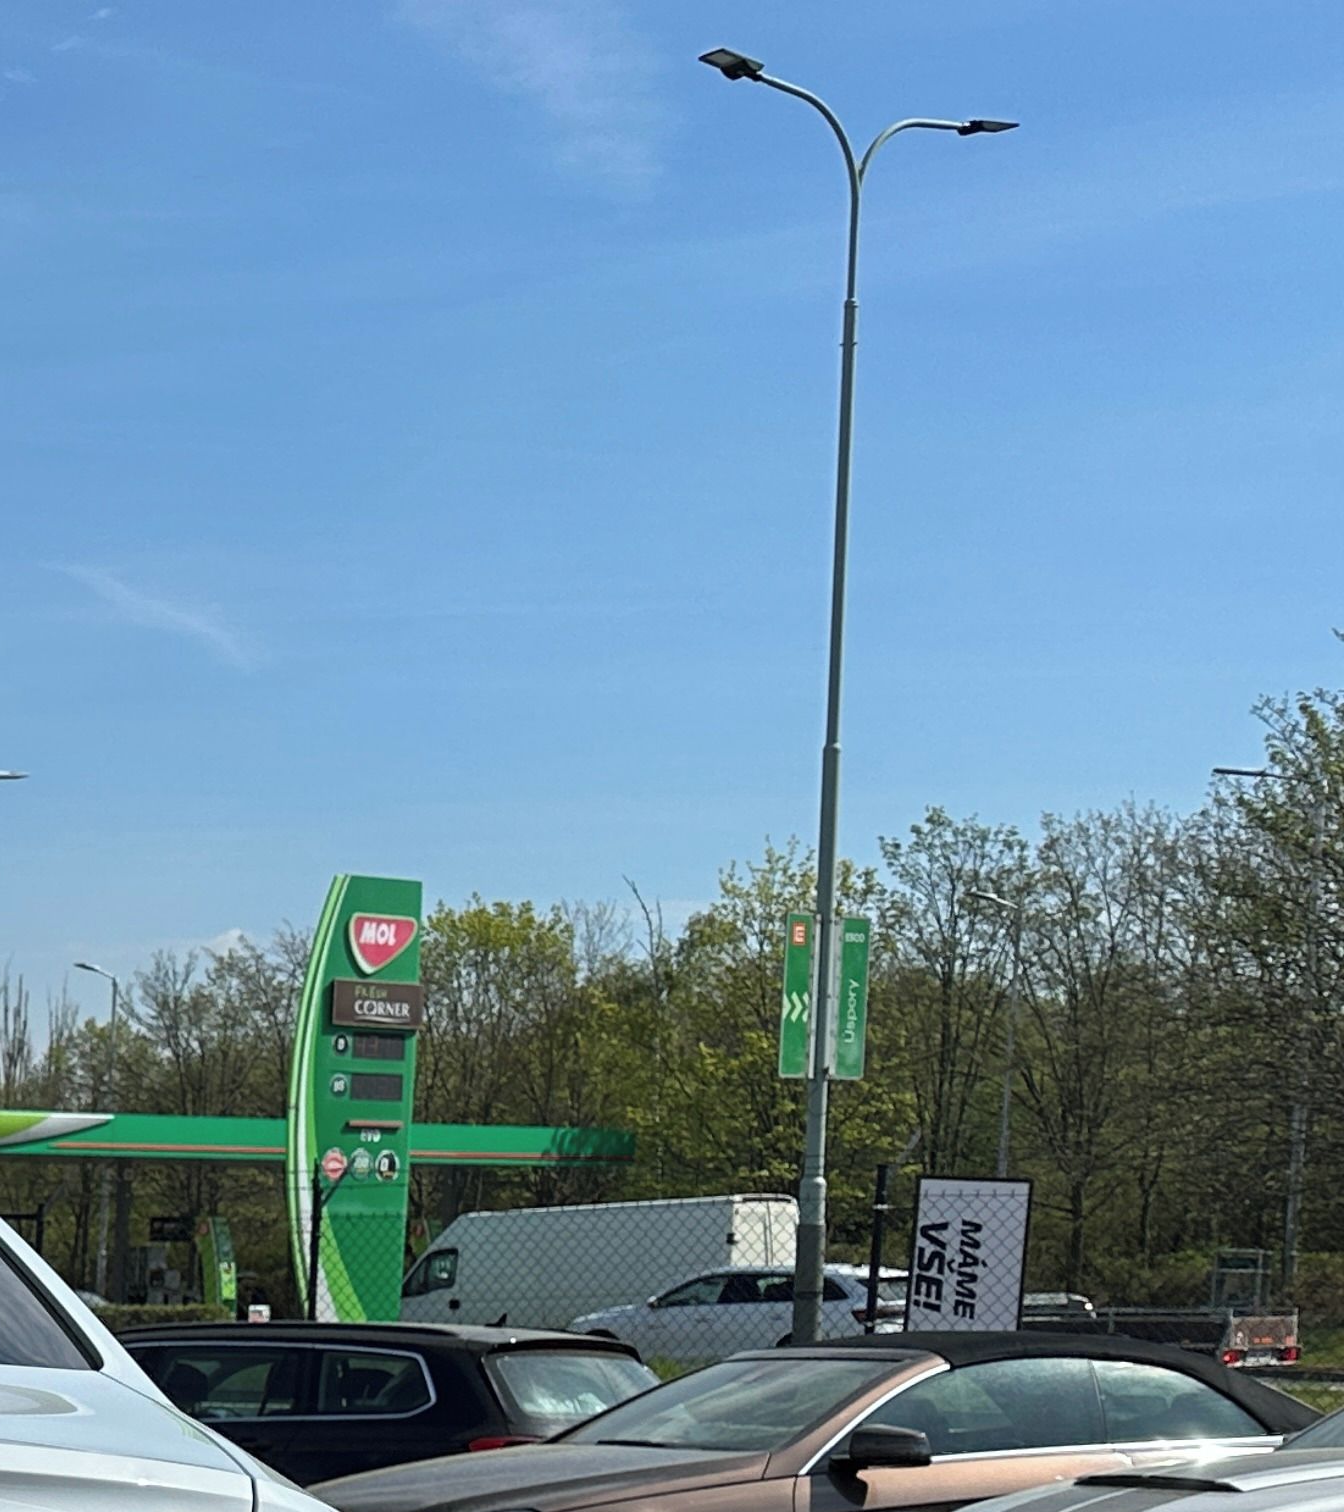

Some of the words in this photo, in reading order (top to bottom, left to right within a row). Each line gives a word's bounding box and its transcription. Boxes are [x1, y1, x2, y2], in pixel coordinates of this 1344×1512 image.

[358, 921, 397, 947] MOL
[354, 999, 410, 1017] CORNER
[913, 1221, 956, 1313] VŠE!
[953, 1219, 988, 1320] MÁME
